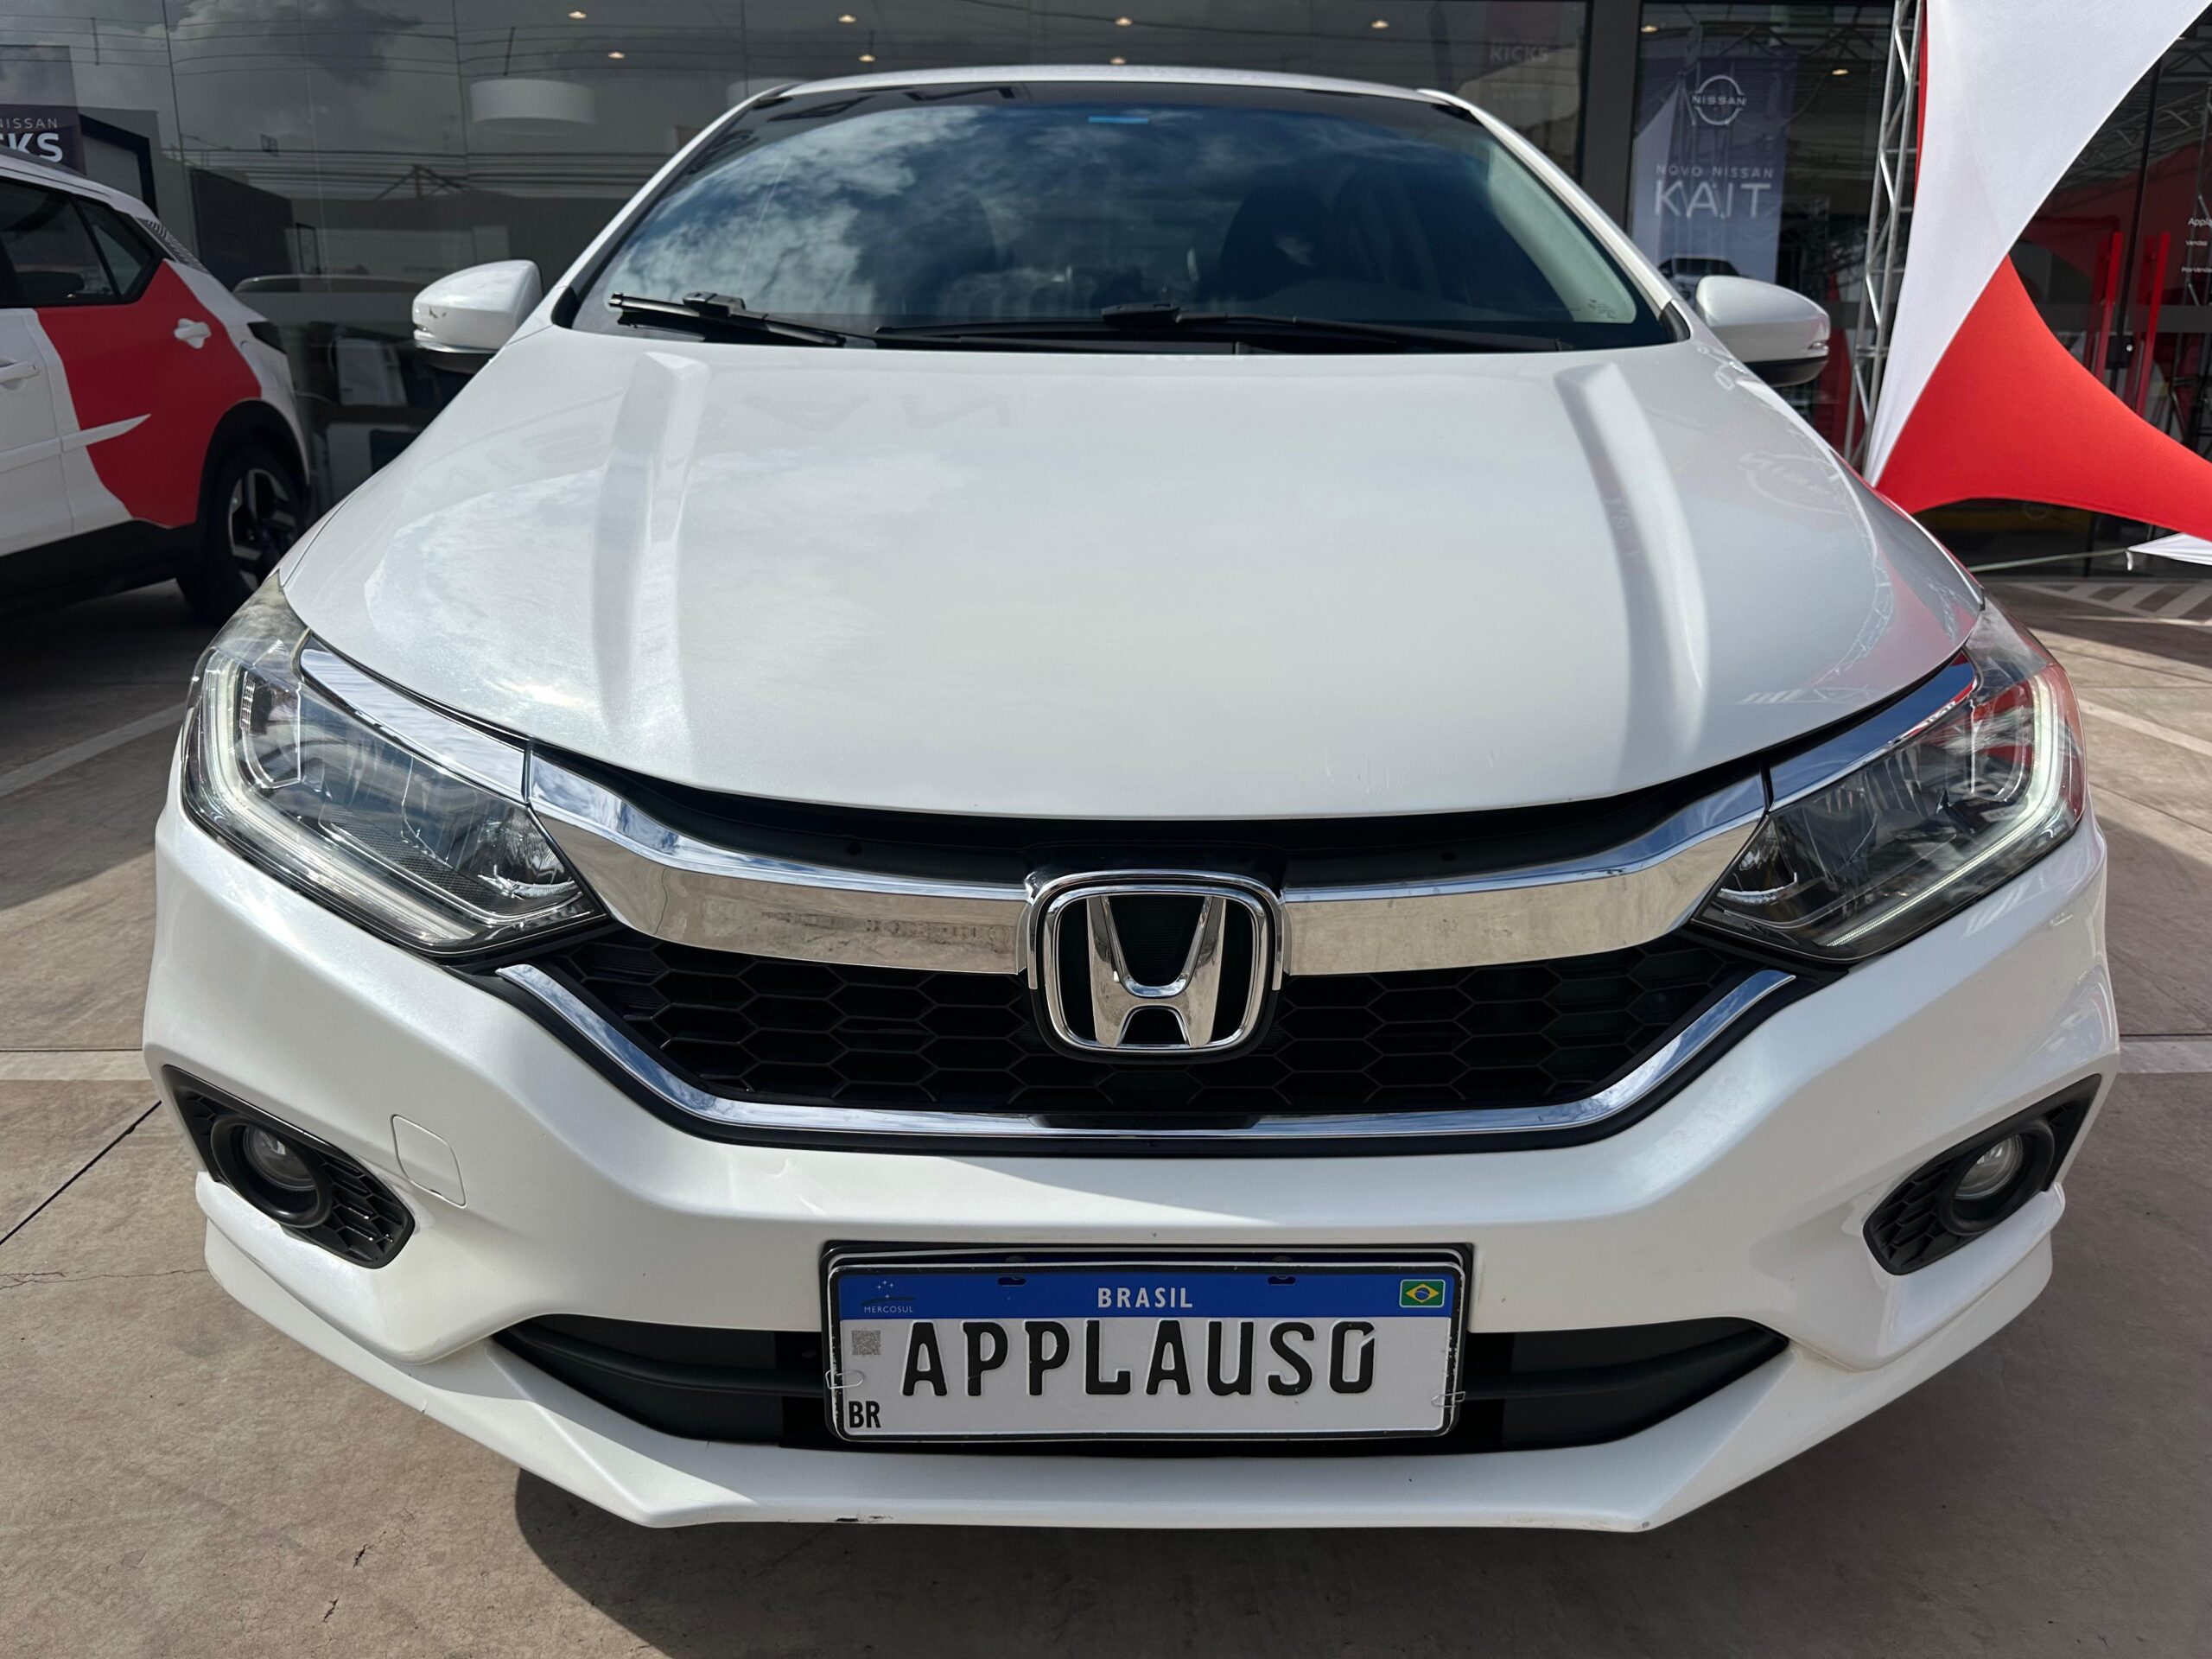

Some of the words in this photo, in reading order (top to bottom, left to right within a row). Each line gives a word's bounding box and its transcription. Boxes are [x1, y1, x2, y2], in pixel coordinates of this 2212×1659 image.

[1692, 95, 1747, 106] NISSAN
[0, 132, 63, 162] KS
[1656, 164, 1703, 177] NOVO
[1712, 167, 1773, 179] NISSAN
[1655, 180, 1771, 219] KAIT
[1097, 1287, 1193, 1309] BRASIL
[863, 1306, 914, 1314] MERCOSUL
[848, 1400, 882, 1429] BR
